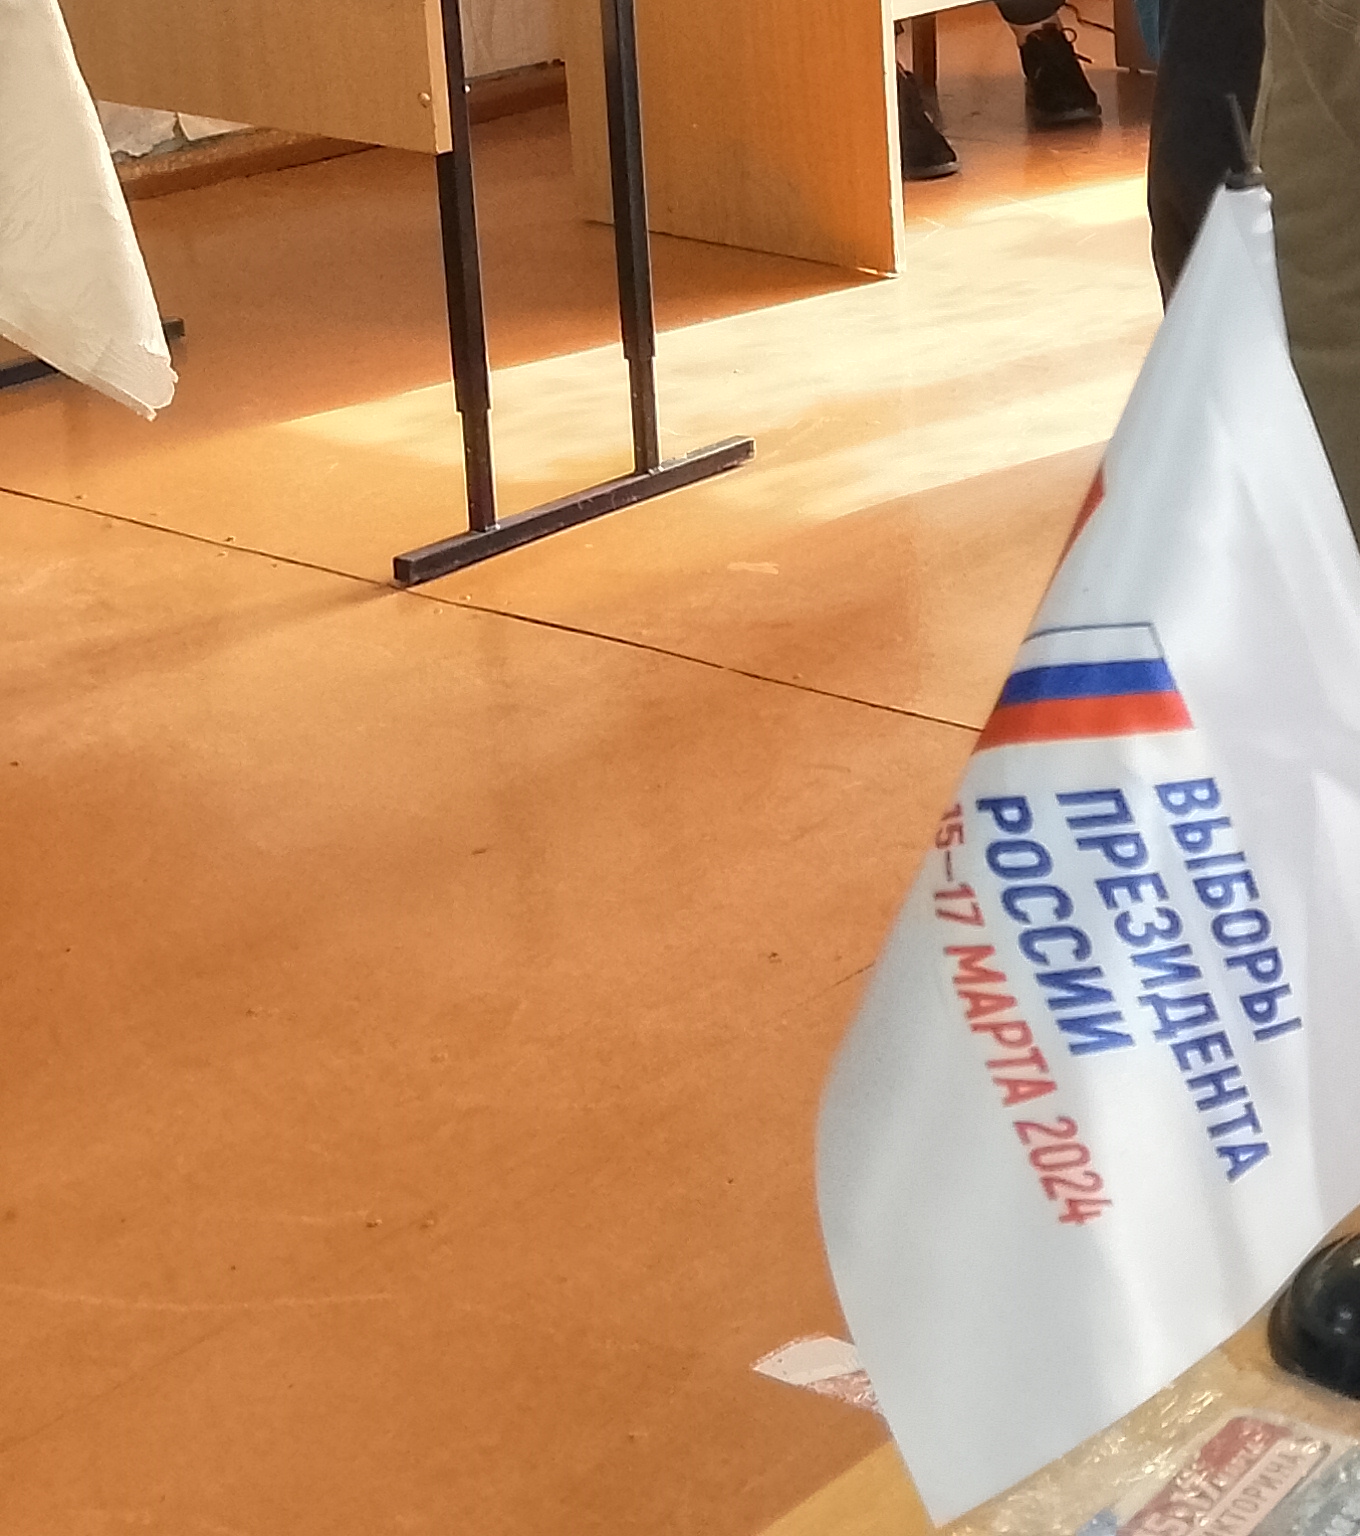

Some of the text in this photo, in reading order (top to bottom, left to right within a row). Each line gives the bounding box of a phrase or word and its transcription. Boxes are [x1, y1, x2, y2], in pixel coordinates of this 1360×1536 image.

[975, 795, 1136, 1056] РОССИИ
[1056, 787, 1272, 1183] ПРЕЗИДЕНТА
[1155, 777, 1302, 1041] ВЫБОРЫ
[943, 944, 1057, 1107] МАРТА
[1013, 1115, 1112, 1226] 2024
